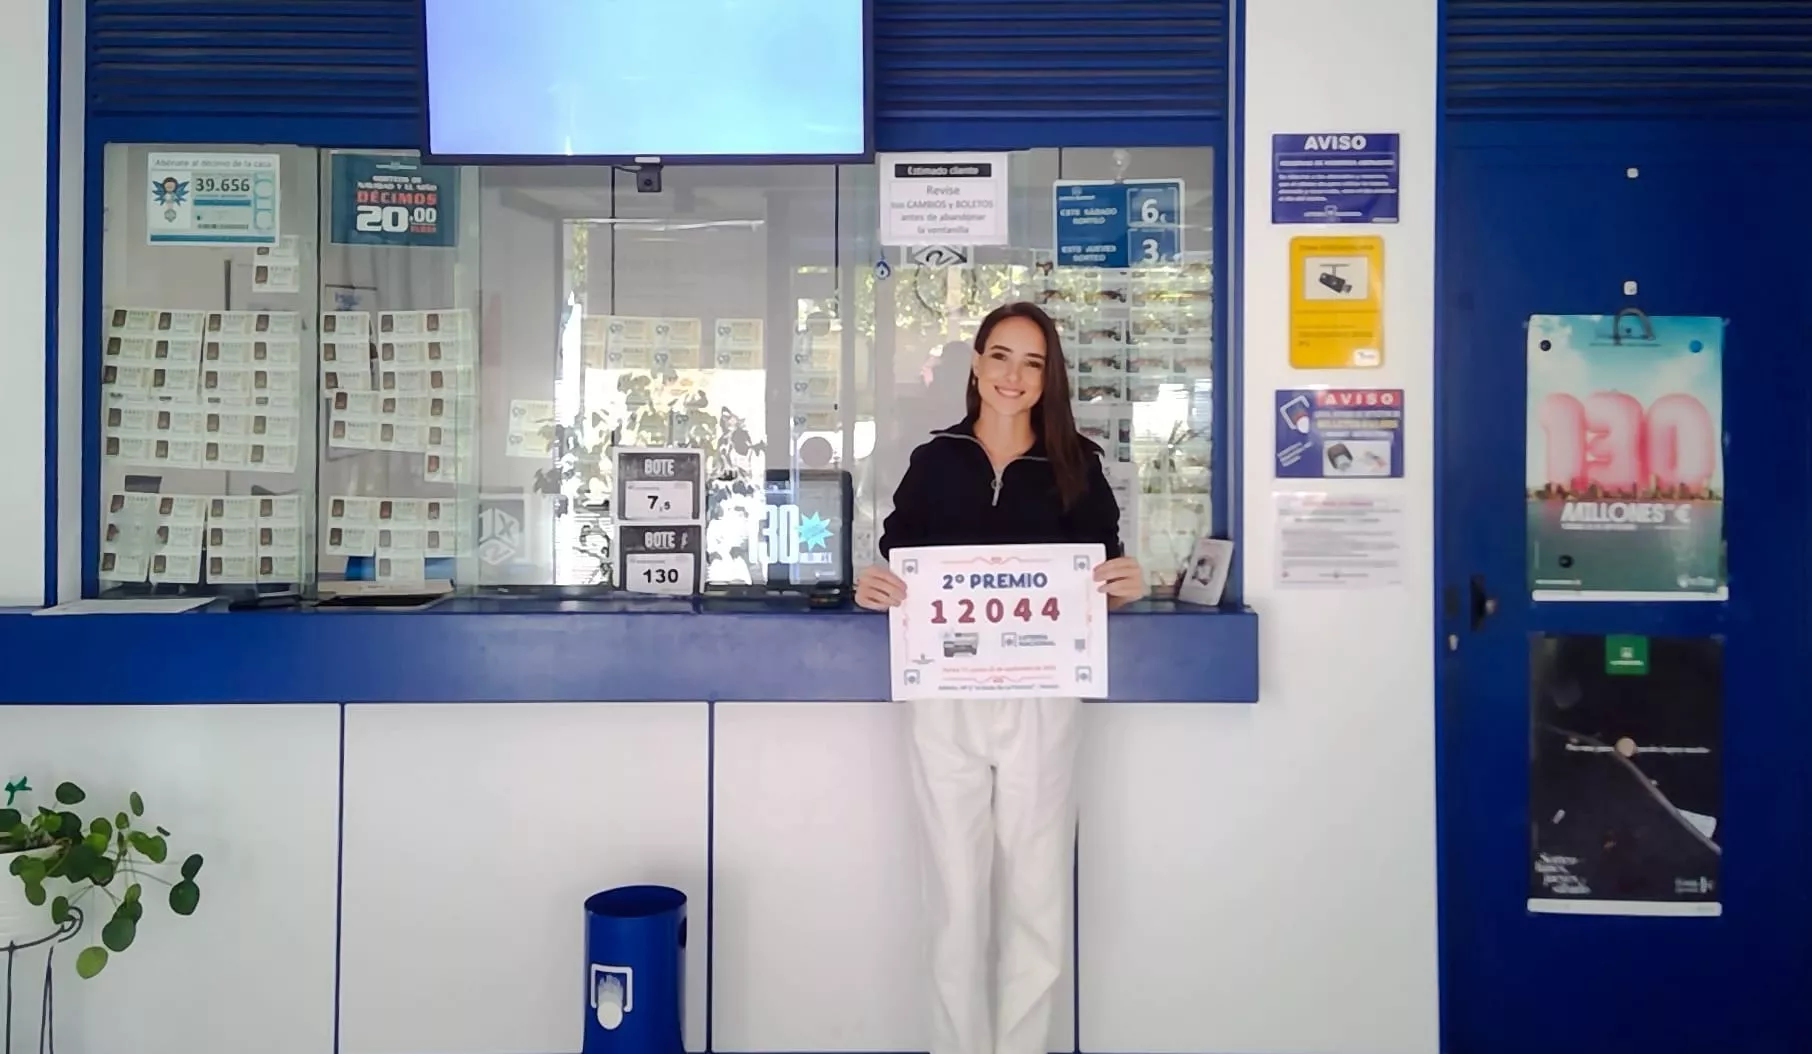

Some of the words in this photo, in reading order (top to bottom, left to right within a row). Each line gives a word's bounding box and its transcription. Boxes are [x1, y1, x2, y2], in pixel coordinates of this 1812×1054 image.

[1304, 136, 1367, 150] AVISO
[195, 178, 250, 192] 39.656
[926, 185, 960, 195] Revise
[906, 200, 946, 209] CAMBIOS
[956, 200, 994, 209] BOLETOS
[926, 213, 938, 221] de
[928, 226, 969, 234] ventanilla
[1325, 393, 1394, 405] AVISO
[1540, 391, 1716, 492] 130
[644, 458, 675, 475] BOTE
[1560, 502, 1665, 523] MILLONES
[644, 531, 676, 548] BOTE
[642, 568, 679, 583] 130
[942, 573, 965, 590] 2º
[970, 572, 1048, 589] PREMIO
